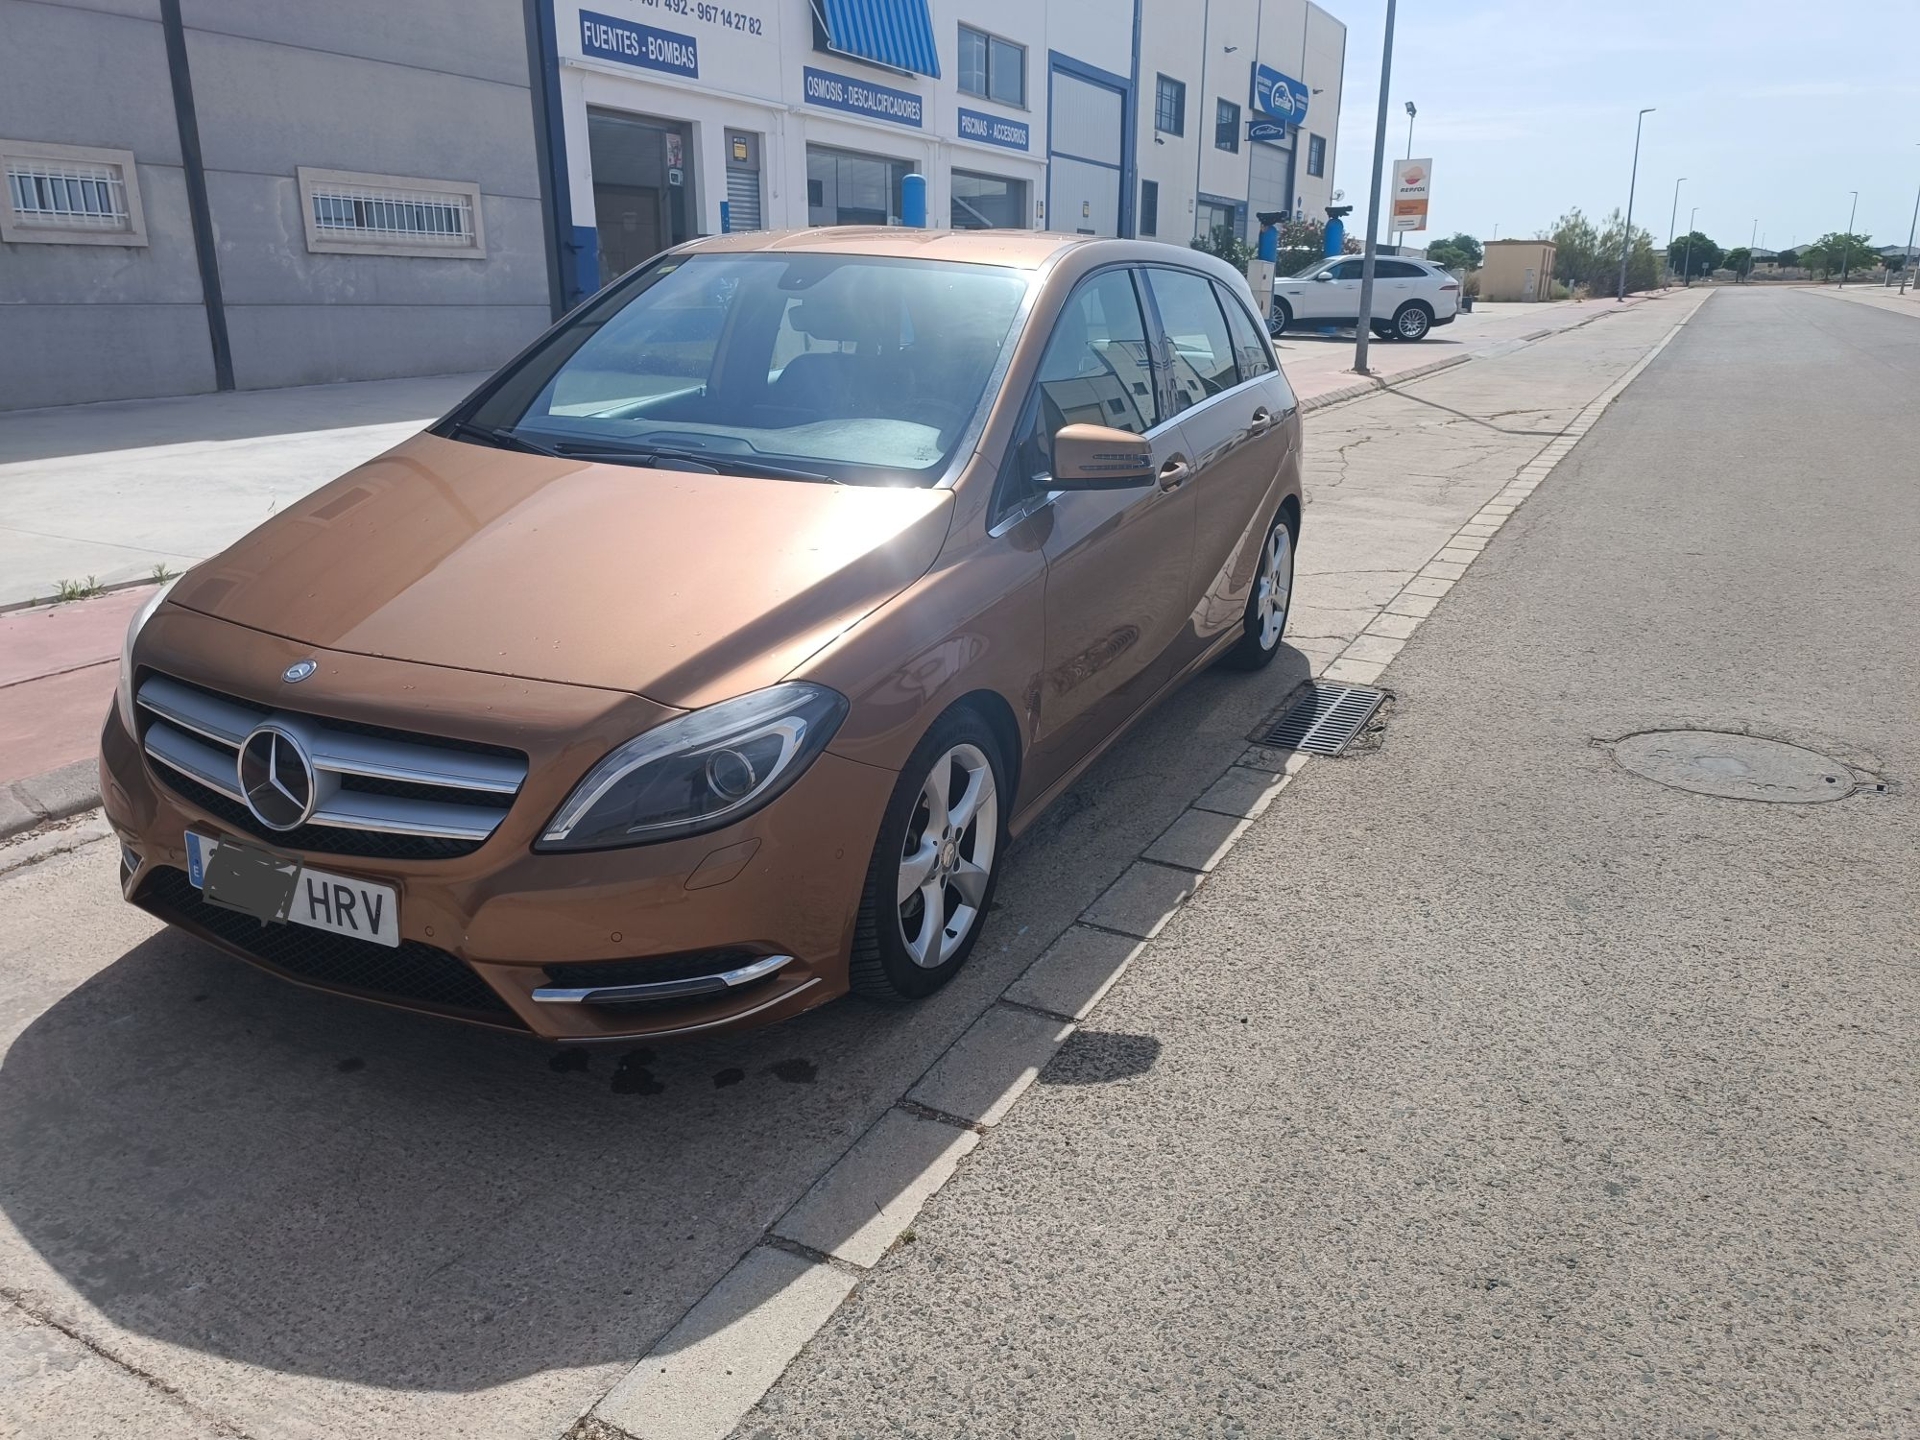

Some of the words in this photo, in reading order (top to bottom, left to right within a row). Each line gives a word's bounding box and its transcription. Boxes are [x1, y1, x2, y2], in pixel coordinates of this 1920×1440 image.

[583, 21, 639, 56] FUENTES
[647, 36, 695, 69] BOMBAS
[807, 76, 843, 102] OSMOSIS
[848, 86, 920, 120] DESCALCIFICADORES
[961, 115, 988, 137] PISCINAS
[993, 123, 1027, 145] ACCESORIOS
[193, 865, 199, 878] E
[306, 877, 383, 935] HRV
